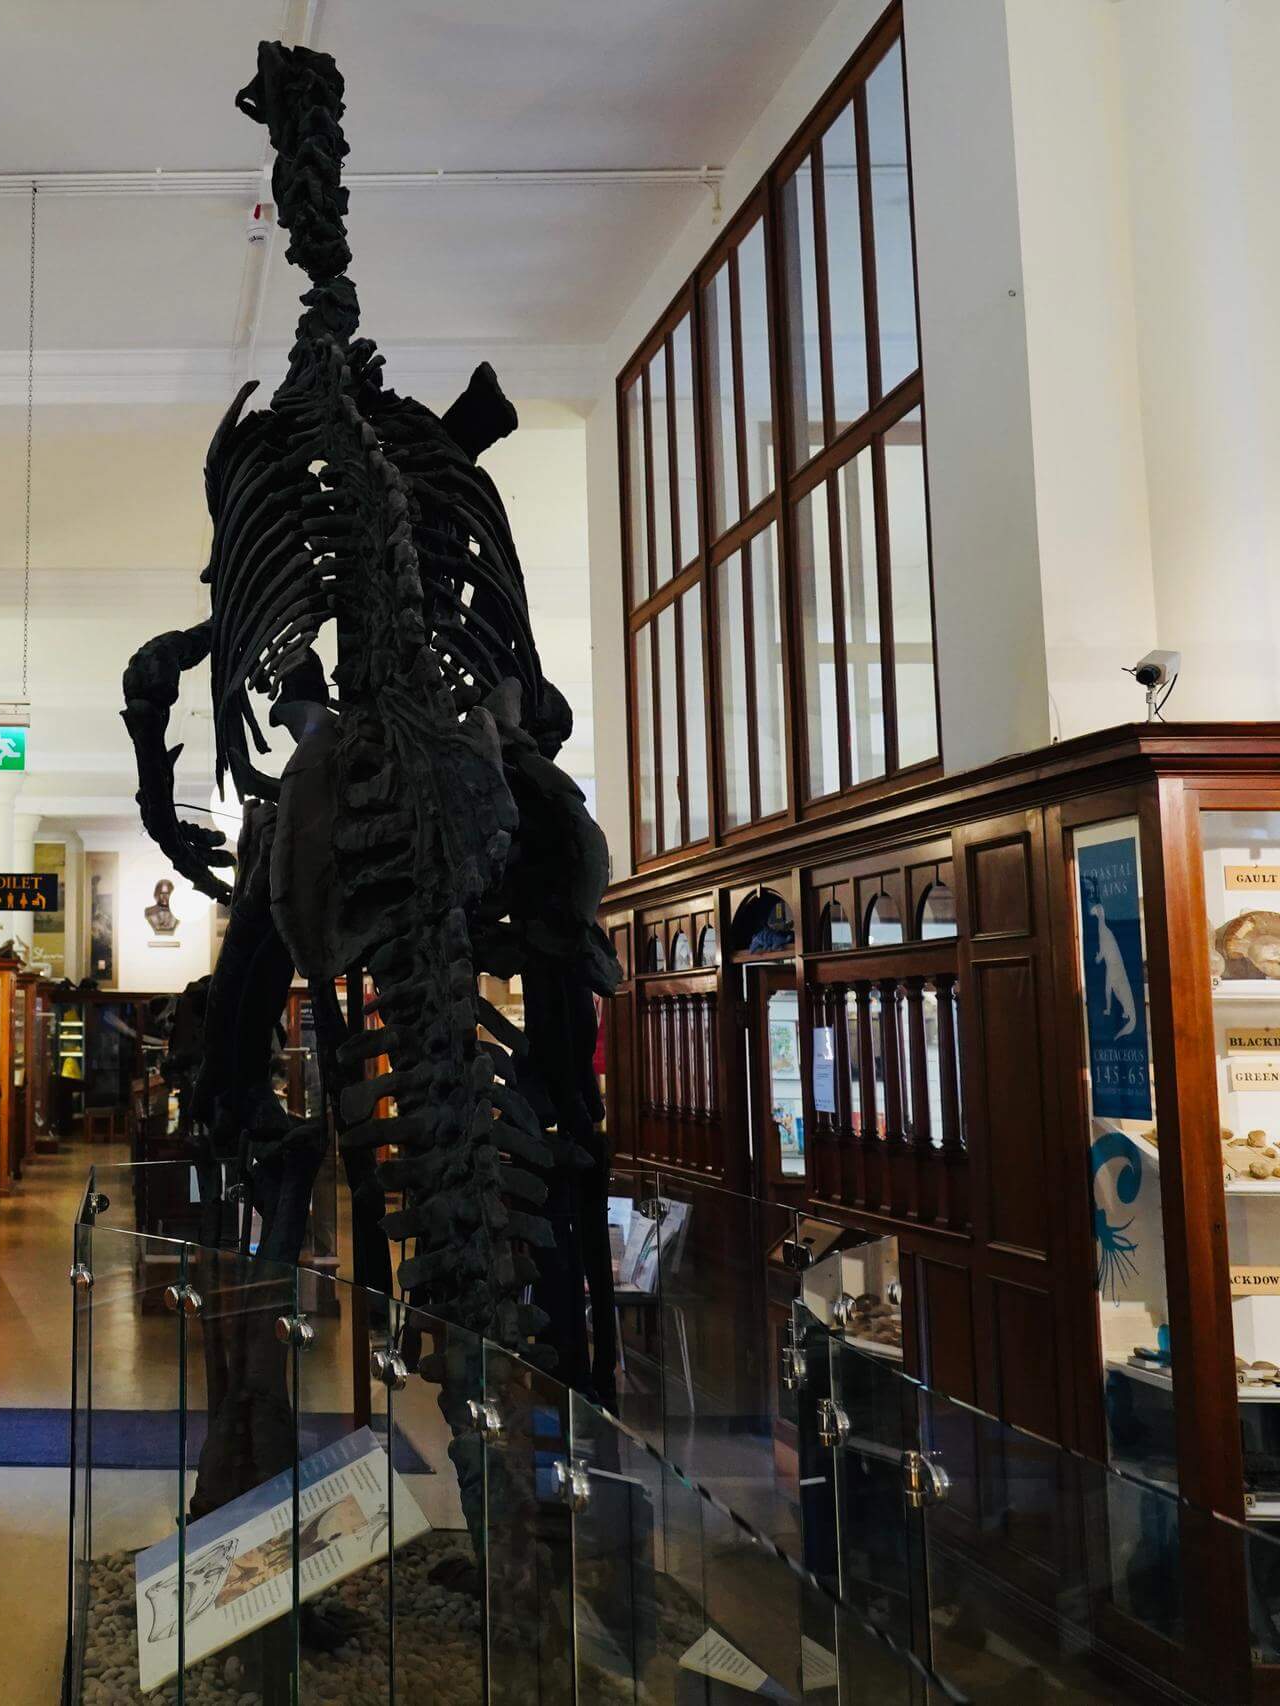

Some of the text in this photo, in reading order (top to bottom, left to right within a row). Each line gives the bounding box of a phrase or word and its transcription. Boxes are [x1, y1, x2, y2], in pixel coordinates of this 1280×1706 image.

[1236, 873, 1277, 883] GAULT
[1212, 977, 1219, 987] 5
[1238, 1376, 1245, 1384] 3
